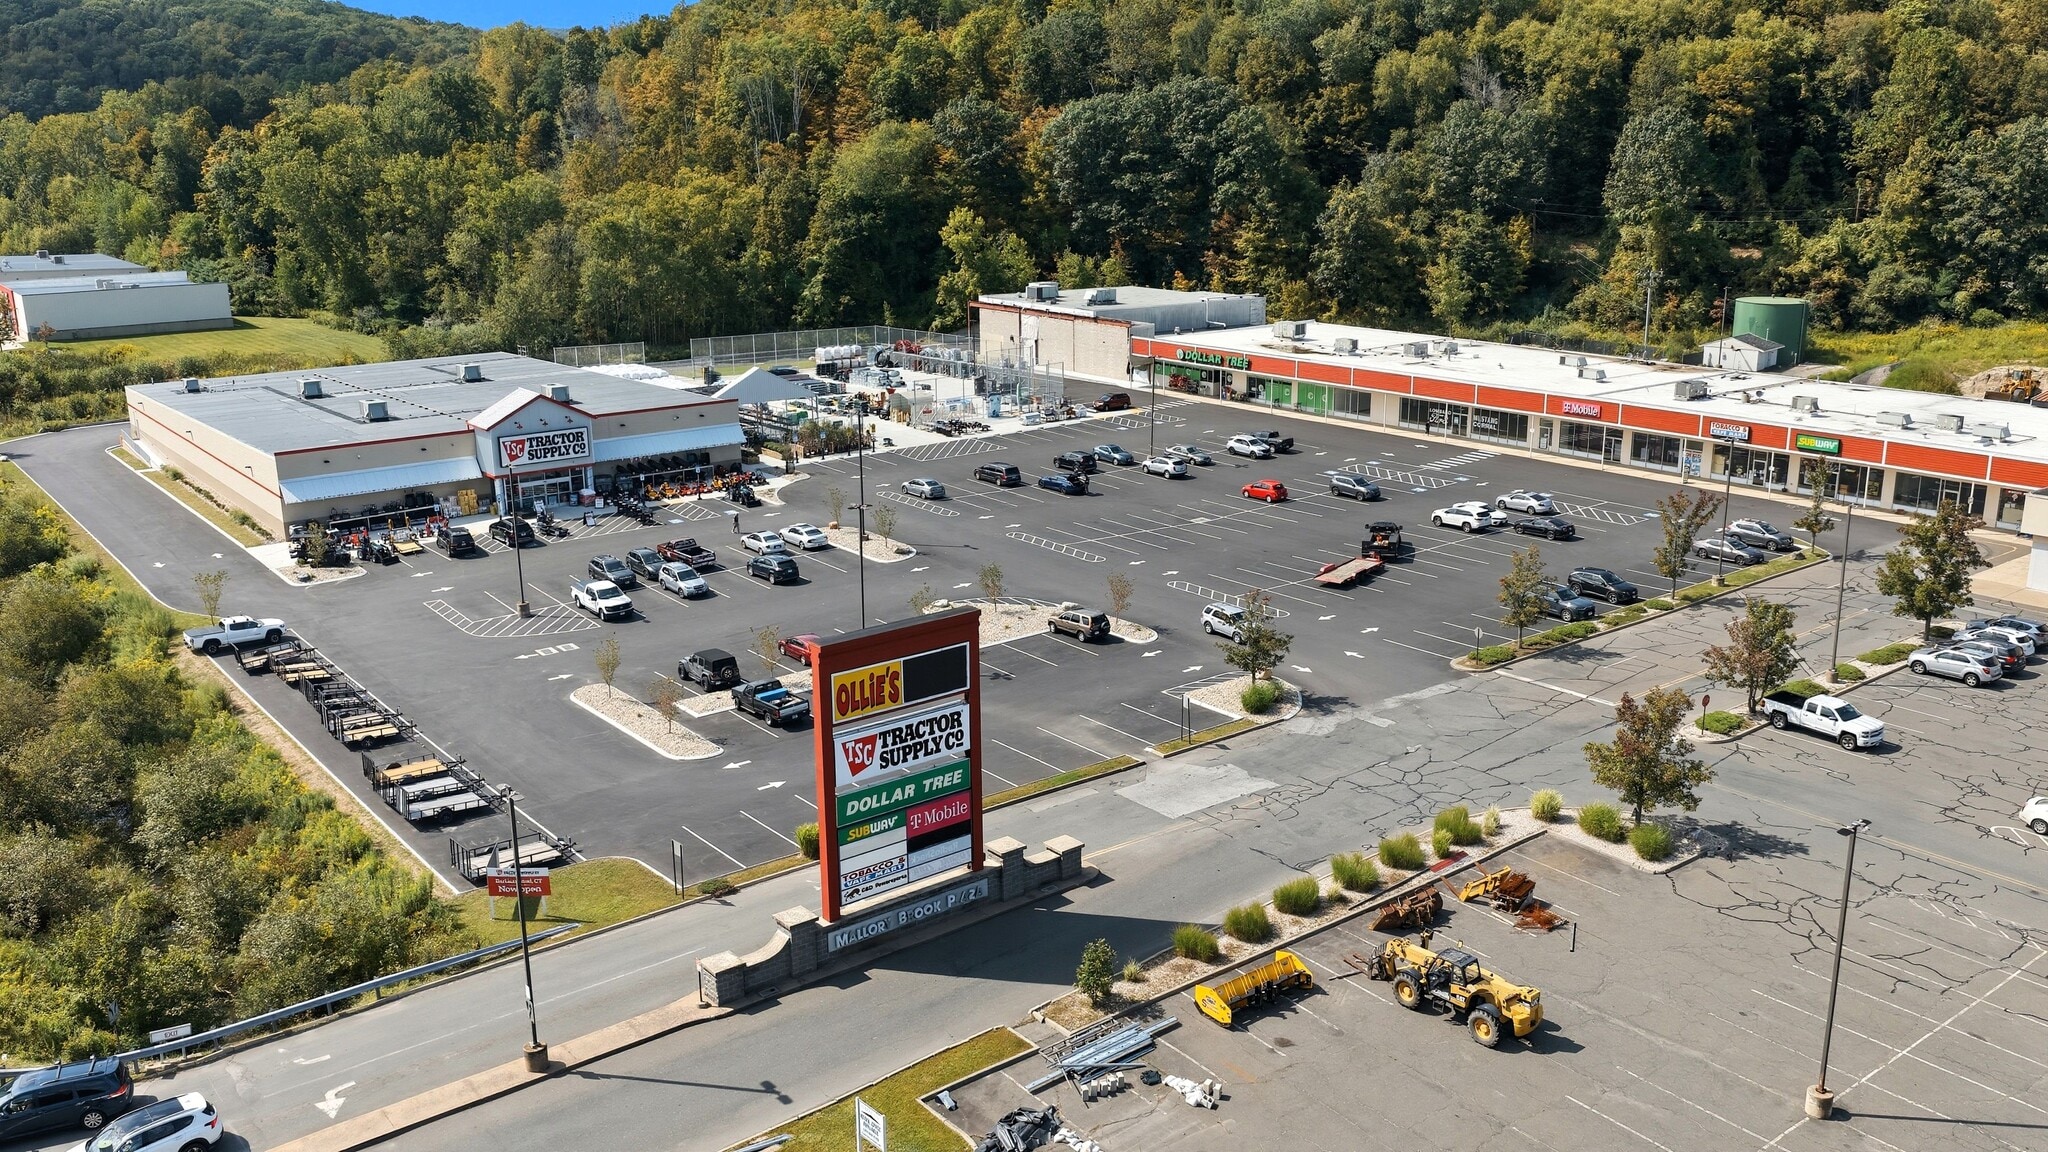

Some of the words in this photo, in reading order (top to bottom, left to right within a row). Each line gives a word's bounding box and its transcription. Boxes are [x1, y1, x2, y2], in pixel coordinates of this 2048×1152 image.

[1185, 351, 1222, 364] DOLLAR
[1225, 356, 1249, 369] TREE
[504, 441, 523, 457] TSC
[526, 431, 585, 449] TRACTOR
[1797, 437, 1838, 450] SUBWAY
[527, 444, 573, 461] SUPPLY
[878, 710, 963, 750] TRACTOR
[846, 741, 873, 765] TSC
[879, 737, 944, 770] SUPPLY
[845, 783, 916, 817] DOLLAR
[923, 769, 964, 794] TREE
[923, 801, 969, 826] Mobile
[847, 815, 899, 842] SUBWAY
[842, 861, 894, 882] TOBACCO
[846, 875, 872, 888] VAPE
[875, 863, 905, 879] MART
[835, 917, 893, 949] MALLORY
[898, 900, 942, 925] BROOK
